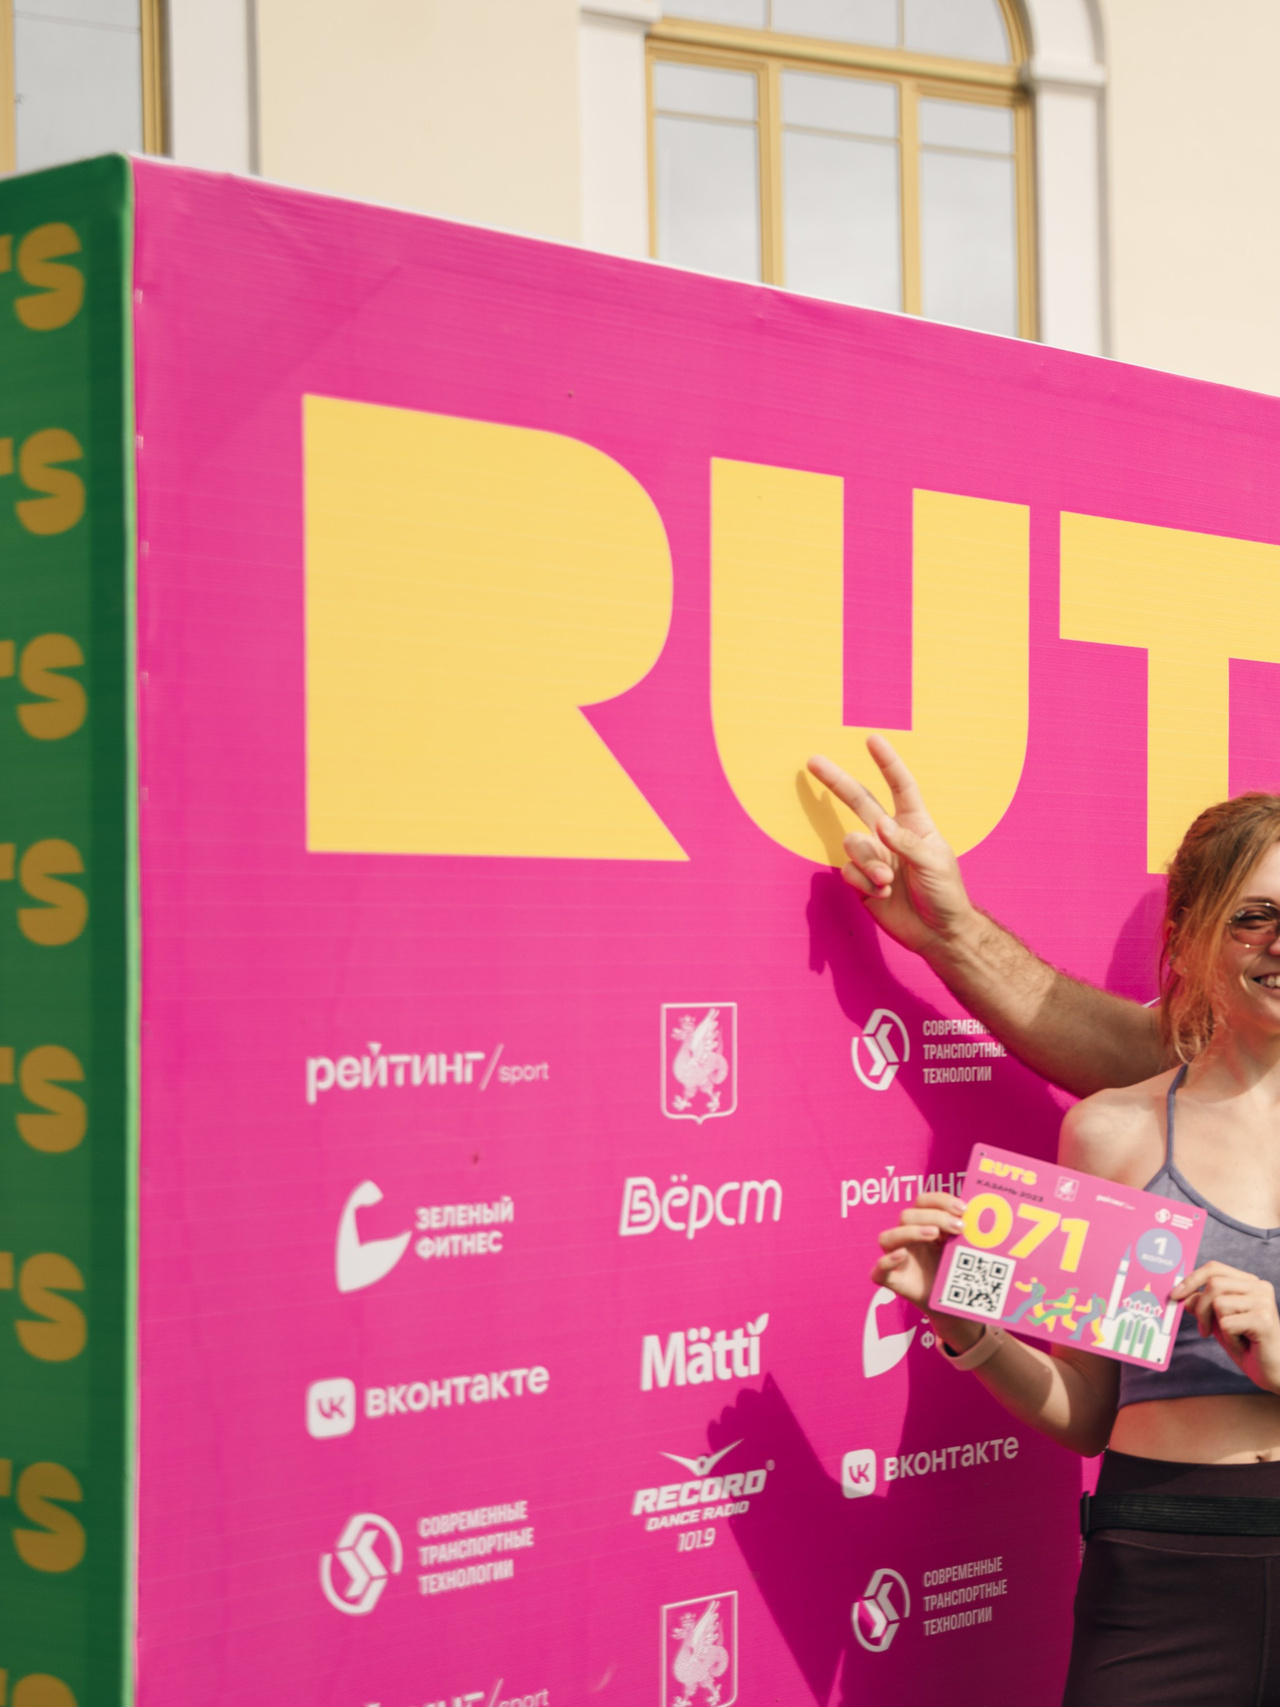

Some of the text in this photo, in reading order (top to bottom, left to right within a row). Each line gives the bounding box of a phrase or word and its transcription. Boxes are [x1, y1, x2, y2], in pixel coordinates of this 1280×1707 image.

[923, 1042, 1007, 1060] ТРАНСПОРТНЫЕ
[923, 1066, 992, 1084] ТЕХНОЛОГИИ
[978, 1158, 1037, 1186] RUTS
[416, 1196, 514, 1230] ЗЕЛЕНЫЙ
[416, 1231, 504, 1260] ФИТНЕС
[962, 1193, 1090, 1273] 071
[1154, 1237, 1167, 1256] 1
[640, 1313, 770, 1391] Mätti
[632, 1468, 767, 1516] RECORD
[418, 1499, 529, 1539] СОВРЕМЕННЫЕ
[646, 1500, 750, 1532] DANCE RADIO
[418, 1526, 535, 1567] ТРАНСПОРТНЫЕ
[418, 1558, 514, 1596] ТЕХНОЛОГИИ
[923, 1556, 1004, 1588] СОВРЕМЕННЫЕ
[923, 1579, 1008, 1612] ТРАНСПОРТНЫЕ
[923, 1606, 993, 1636] ТЕХНОЛОГИИ
